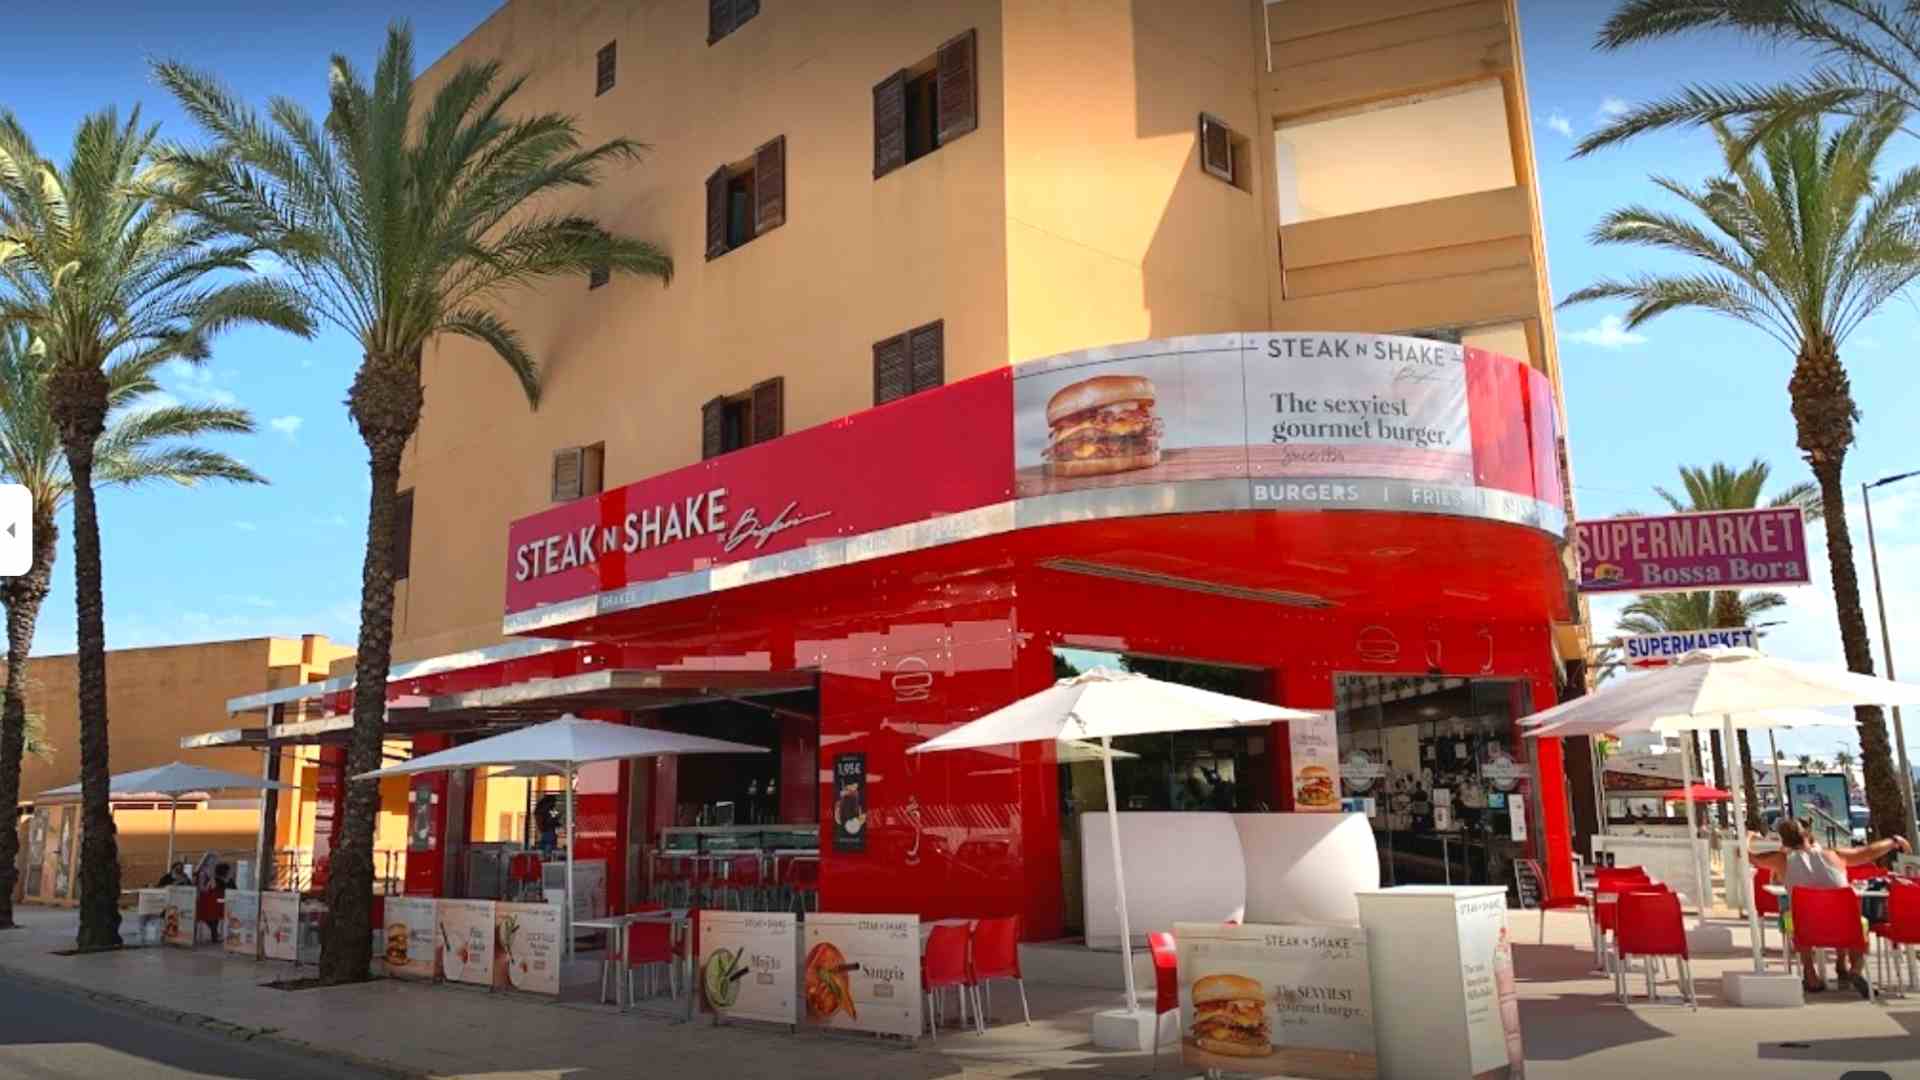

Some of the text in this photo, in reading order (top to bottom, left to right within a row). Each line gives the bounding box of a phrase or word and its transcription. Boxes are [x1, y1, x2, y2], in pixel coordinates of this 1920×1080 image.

[1267, 339, 1445, 367] STEAK N SHAKE
[1270, 392, 1409, 421] The sexyiest
[1272, 418, 1452, 448] gourmet burger.
[1253, 485, 1360, 502] BURGERS
[515, 488, 728, 581] STEAK N SHAKE
[1576, 512, 1796, 563] SUPERMARKET
[1640, 557, 1801, 585] Bossa Bora
[1264, 935, 1298, 946] STEAK
[1311, 936, 1353, 950] SHAKE
